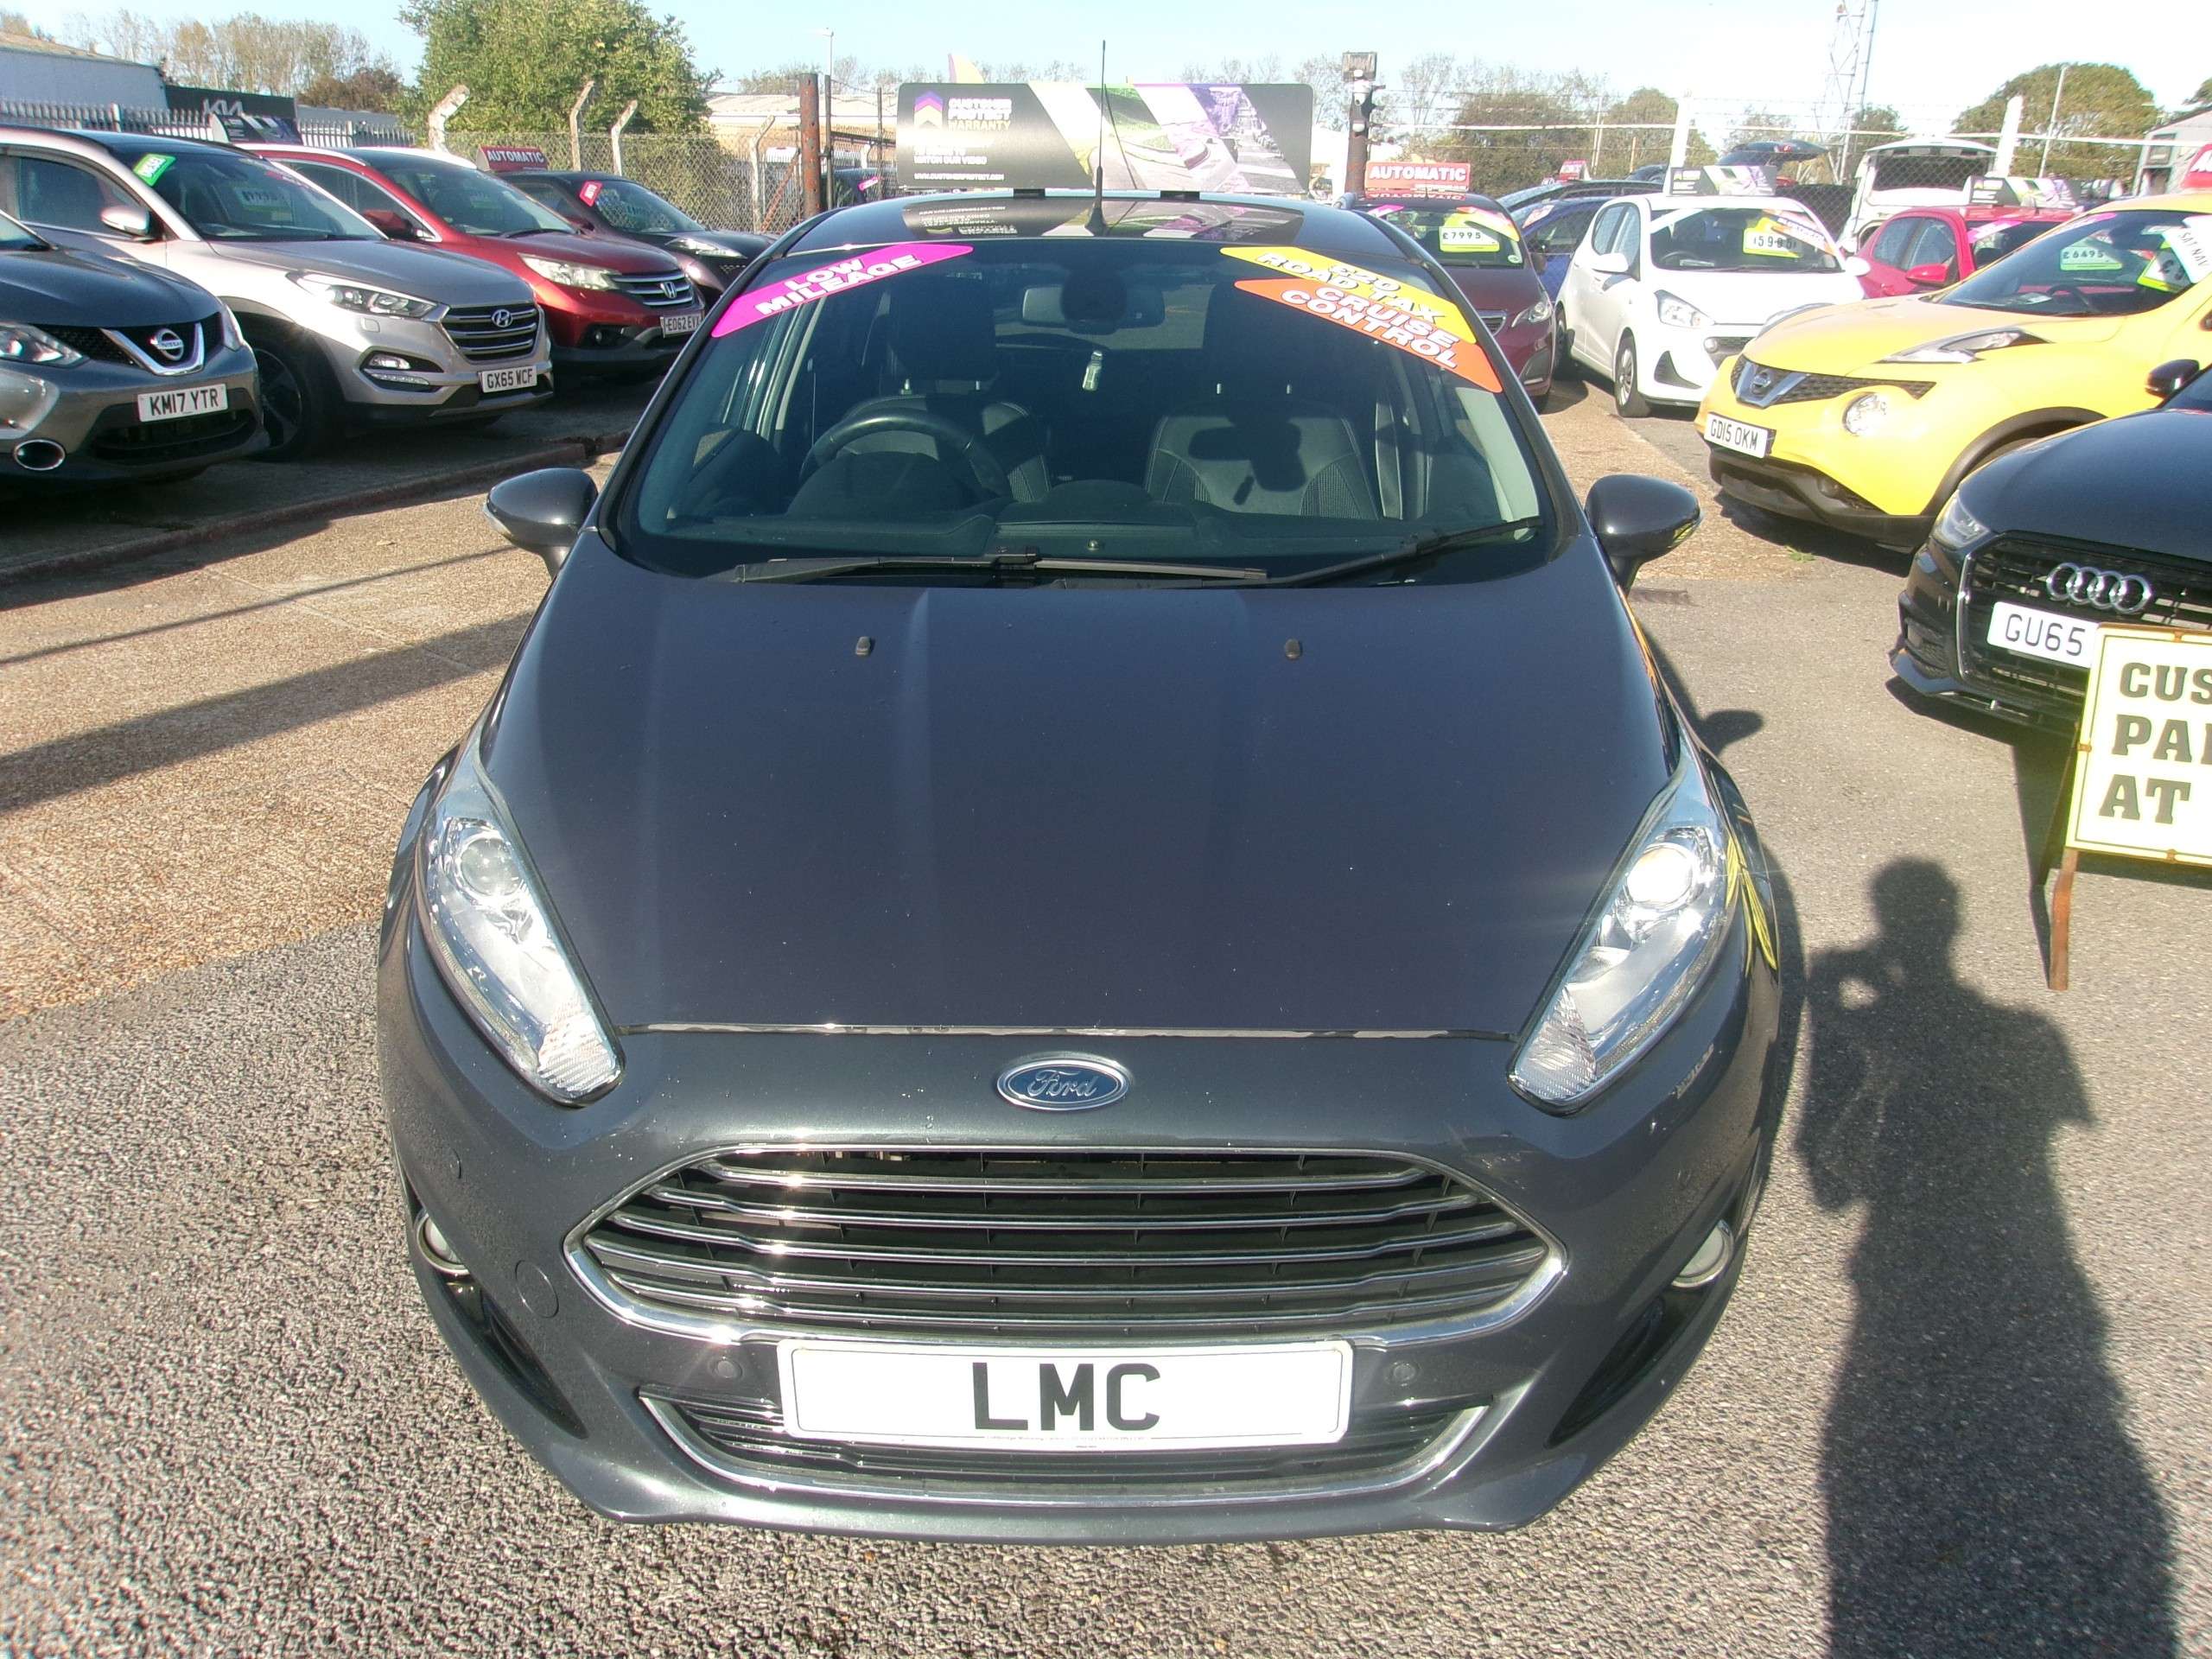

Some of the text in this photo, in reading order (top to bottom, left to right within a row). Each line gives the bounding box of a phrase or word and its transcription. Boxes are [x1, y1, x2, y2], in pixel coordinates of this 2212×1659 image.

[948, 119, 1011, 130] WARRANTY
[486, 150, 544, 163] AUTOMATIC
[1369, 165, 1466, 181] AUTOMATIC
[754, 254, 924, 315] MILEAGE
[784, 258, 865, 291] LOW
[1255, 252, 1446, 325] ROAD TAX
[1281, 289, 1459, 369] CONTROL
[1315, 287, 1460, 349] CRUISE
[486, 372, 514, 389] GX65
[149, 388, 219, 416] KM17 YTR
[1711, 419, 1758, 450] GD15 OKM
[2005, 613, 2086, 657] GU65
[2098, 773, 2191, 824] AT
[1027, 1070, 1100, 1096] Ford
[972, 1361, 1162, 1432] LMC
